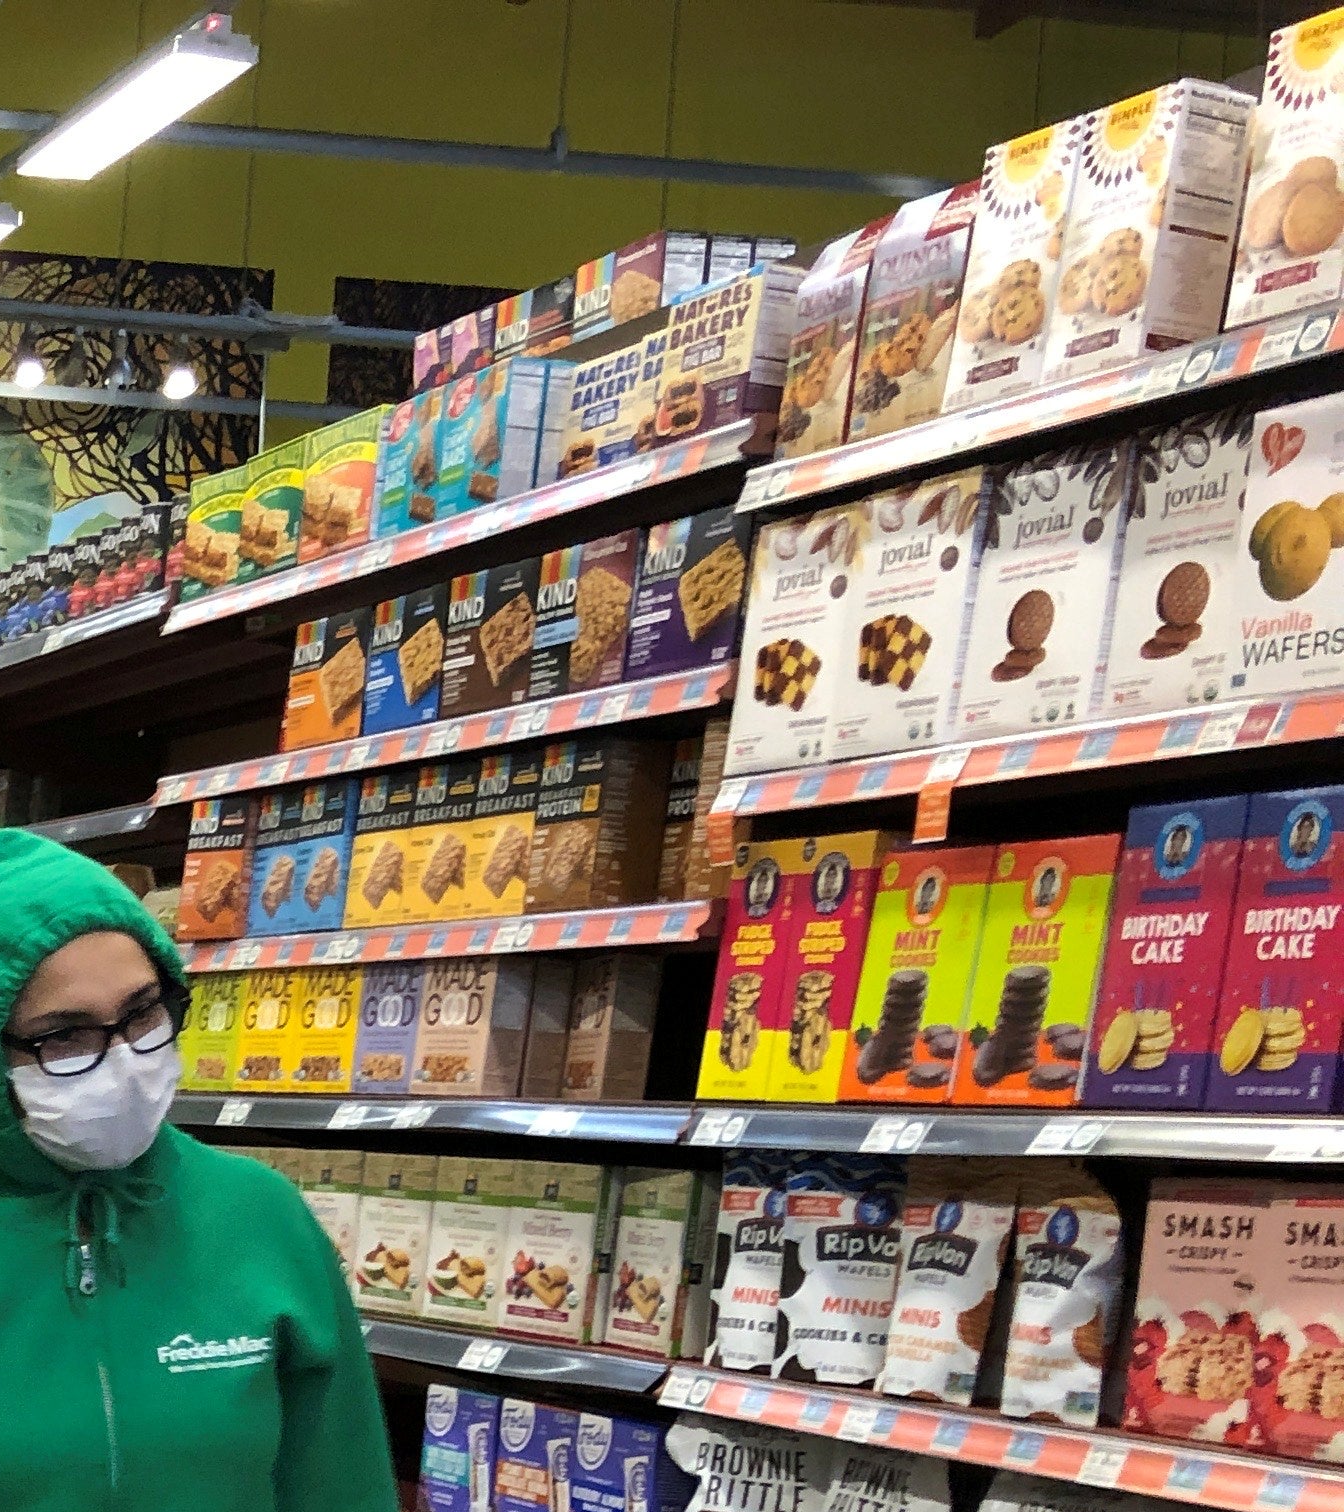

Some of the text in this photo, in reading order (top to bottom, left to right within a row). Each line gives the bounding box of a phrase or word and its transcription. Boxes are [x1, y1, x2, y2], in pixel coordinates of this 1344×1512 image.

[575, 285, 611, 318] KIND
[669, 304, 750, 350] BAKERY
[571, 372, 639, 411] BAKERY
[1162, 472, 1230, 520] jovial
[1014, 503, 1074, 549] jovial
[643, 544, 685, 578] KIND
[878, 533, 934, 576] jovial
[537, 579, 577, 610] KIND
[773, 561, 824, 601] jovial
[449, 597, 484, 624] KIND
[373, 622, 402, 645] KIND
[1242, 610, 1312, 641] Vanilla
[293, 644, 324, 668] KIND
[414, 800, 472, 824] BREAKFAST
[475, 793, 536, 816] BREAKFAST
[188, 834, 244, 850] BREAKFAST
[1120, 911, 1210, 941] BIRTHDAY
[1244, 904, 1342, 936] BIRTHDAY
[894, 929, 942, 951] MINT
[1011, 921, 1065, 947] MINT
[1256, 933, 1316, 961] CAKE
[1130, 938, 1186, 965] CAKE
[247, 974, 294, 1000] MADE
[303, 972, 353, 999] MADE
[427, 961, 488, 991] MADE
[740, 1223, 767, 1250] Rip
[1163, 1213, 1255, 1240] SMASH
[1284, 1221, 1344, 1248] SMA
[823, 1233, 865, 1257] Rip
[731, 1286, 780, 1307] MINIS
[822, 1296, 895, 1319] MINIS
[899, 1307, 941, 1329] MINIS
[852, 1329, 863, 1342] &
[695, 1442, 808, 1484] BROWNIE
